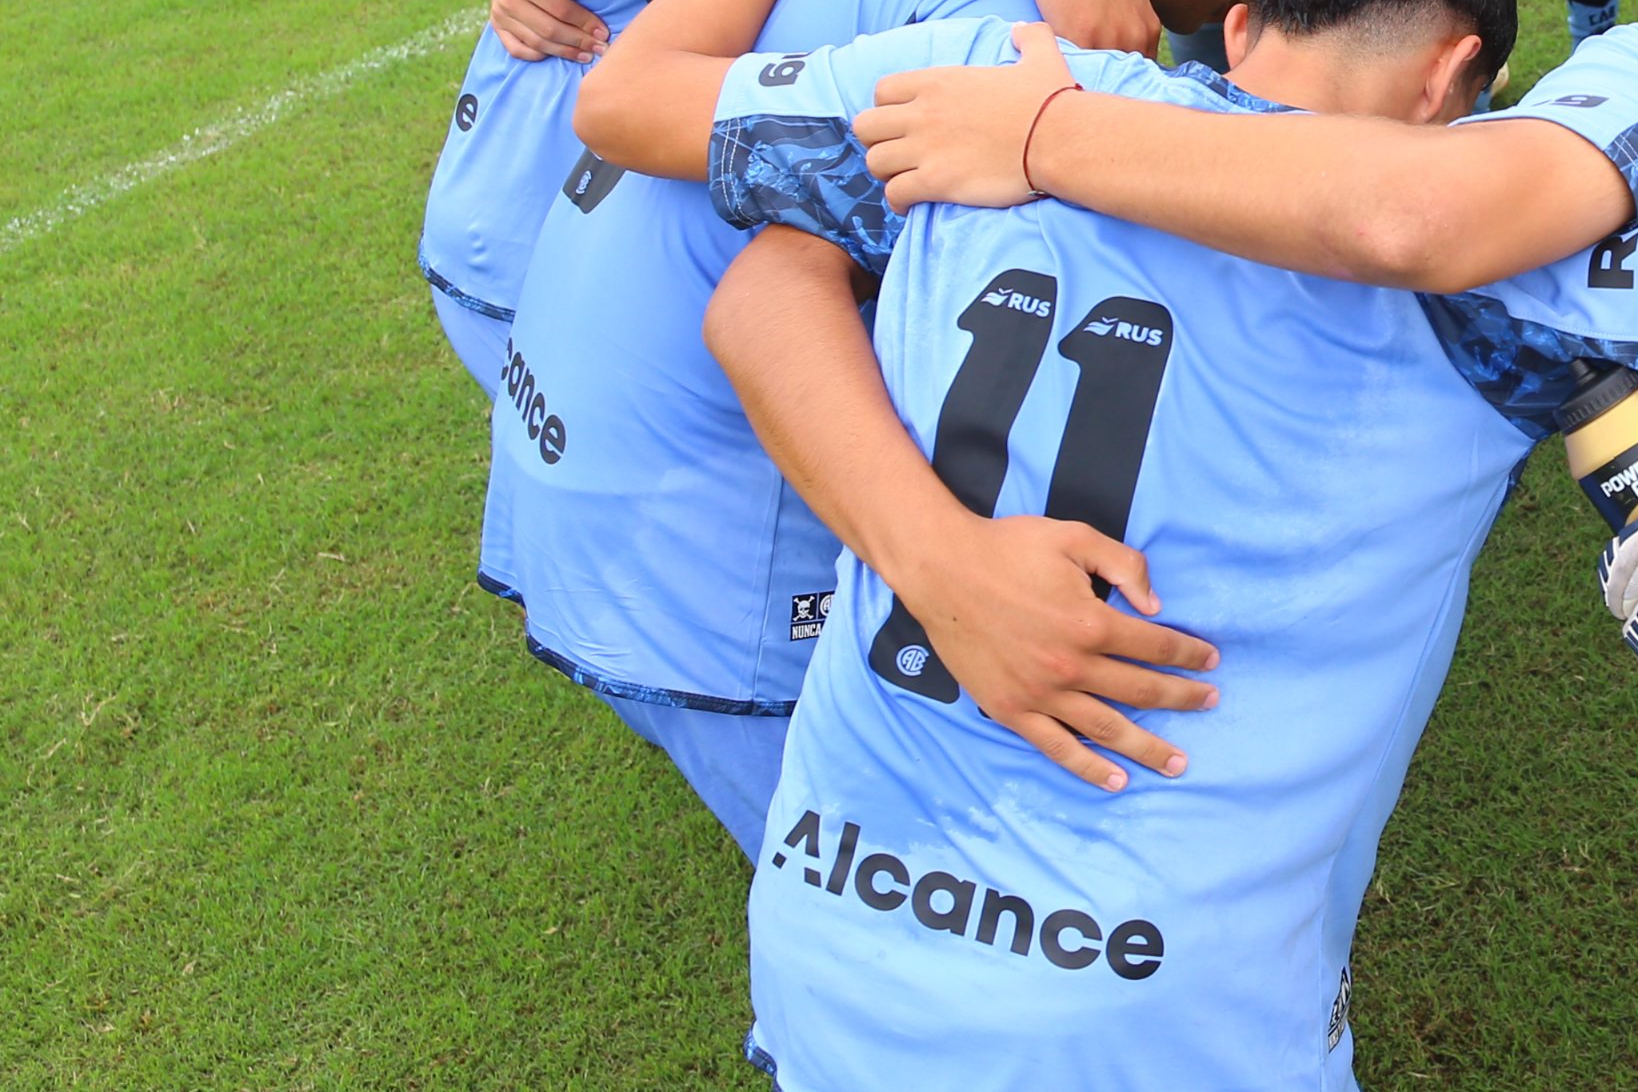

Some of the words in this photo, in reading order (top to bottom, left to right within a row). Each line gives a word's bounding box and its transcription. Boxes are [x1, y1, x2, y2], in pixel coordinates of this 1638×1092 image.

[1008, 292, 1051, 318] RUS
[1115, 321, 1164, 347] RUS
[792, 623, 823, 640] NUNCA
[772, 809, 1165, 981] Alcance
